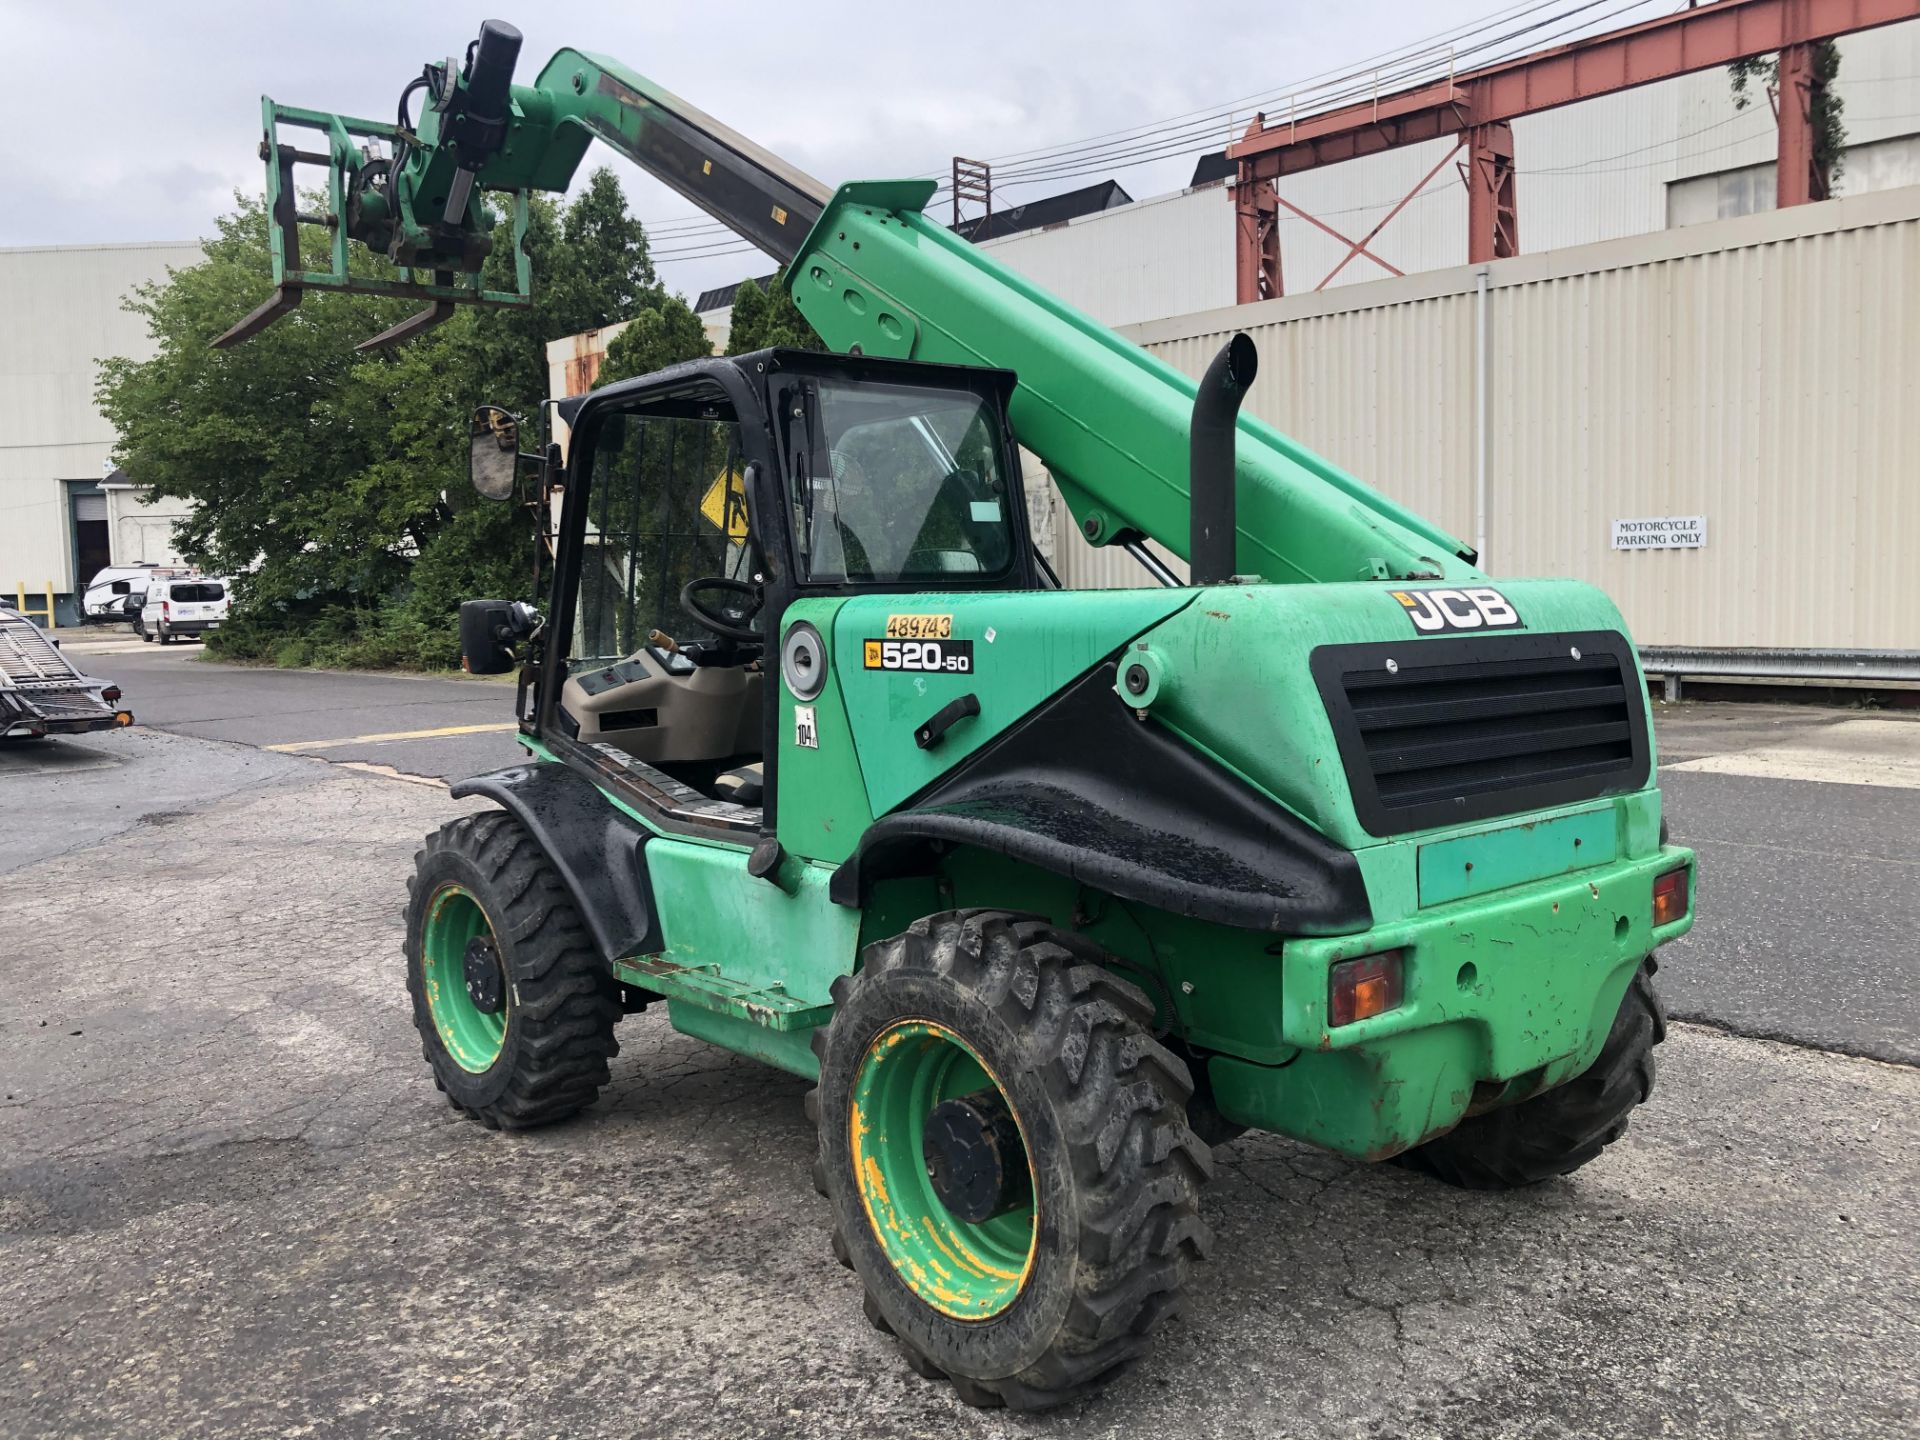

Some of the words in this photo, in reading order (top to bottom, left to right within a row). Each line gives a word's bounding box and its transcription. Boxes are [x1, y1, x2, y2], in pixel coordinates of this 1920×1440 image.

[1620, 520, 1697, 533] MOTORCYCLE
[1616, 534, 1667, 545] PARKING
[1671, 533, 1702, 544] ONLY
[1409, 589, 1518, 630] JCB
[887, 616, 950, 638] 489743
[798, 724, 812, 746] 104
